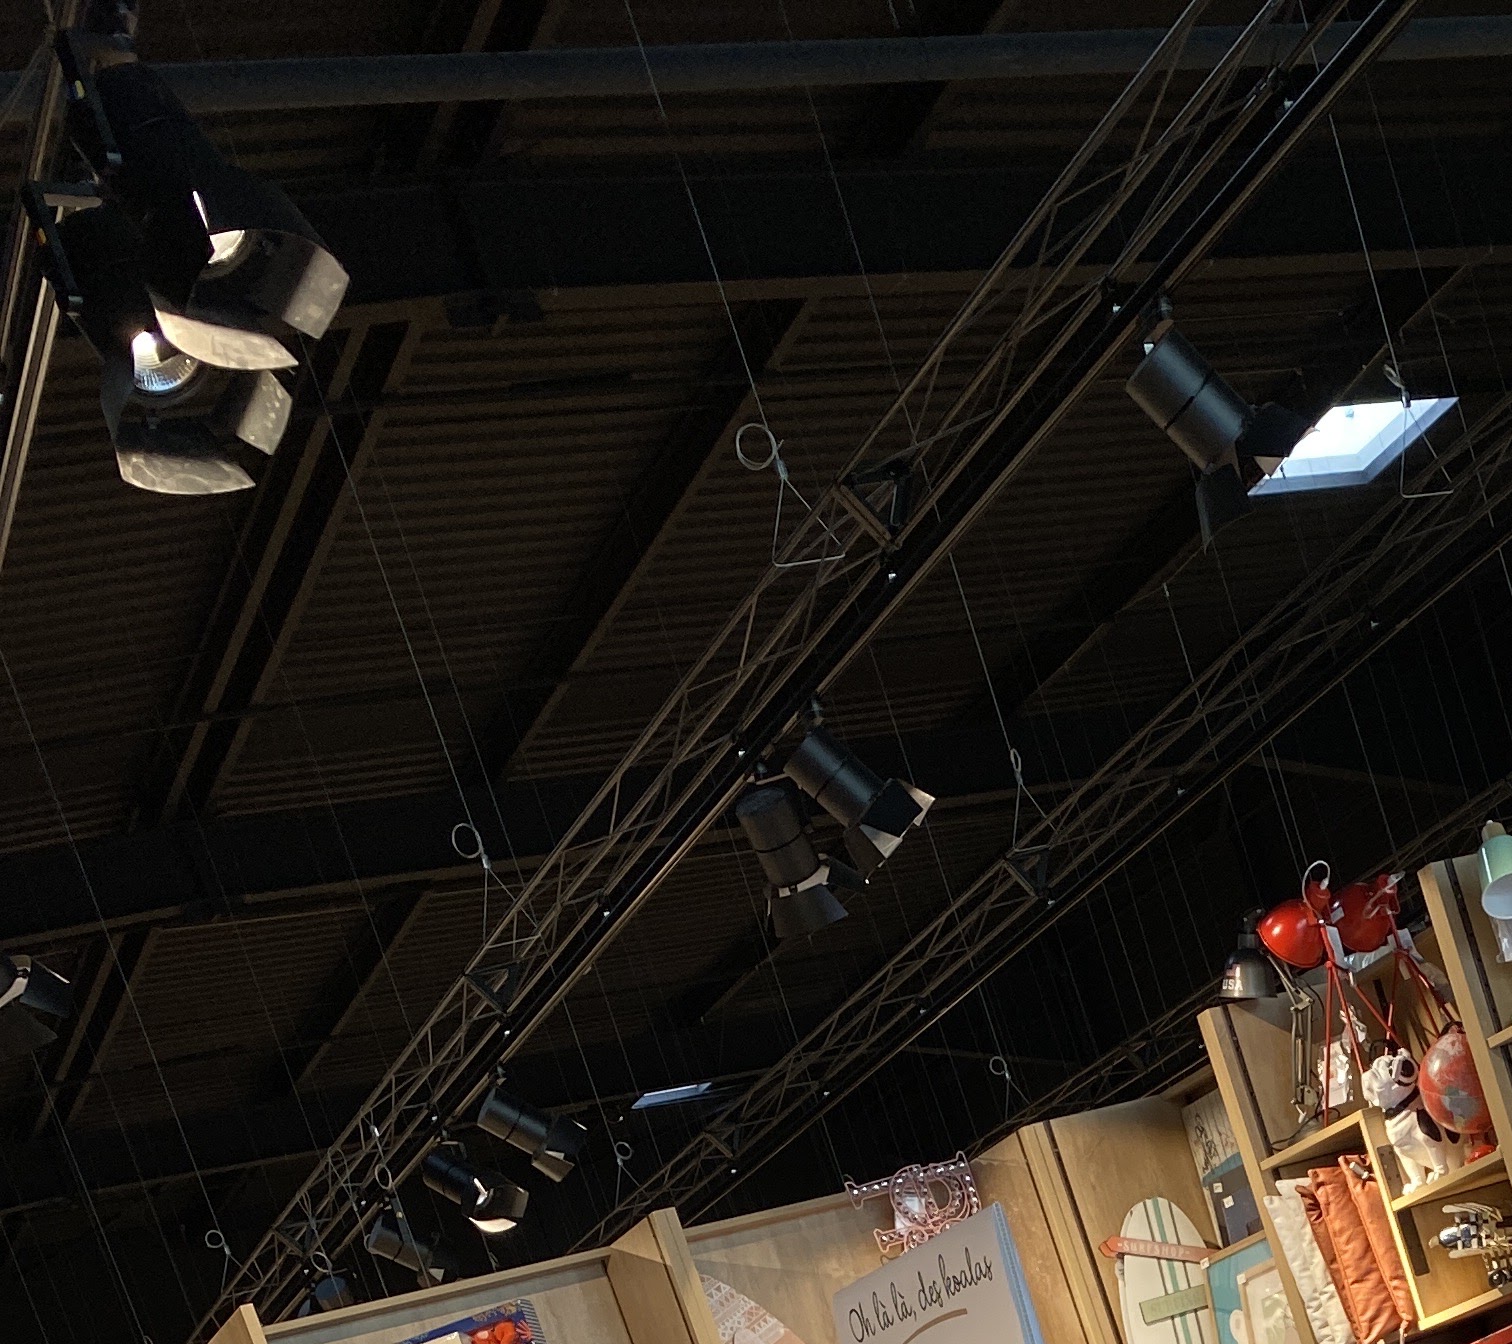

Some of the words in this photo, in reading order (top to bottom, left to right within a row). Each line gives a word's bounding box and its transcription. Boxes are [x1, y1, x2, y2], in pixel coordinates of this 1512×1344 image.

[1222, 978, 1243, 991] USA
[848, 1302, 876, 1343] Oh
[872, 1291, 894, 1331] là
[918, 1271, 943, 1311] des
[937, 1247, 993, 1300] koalas
